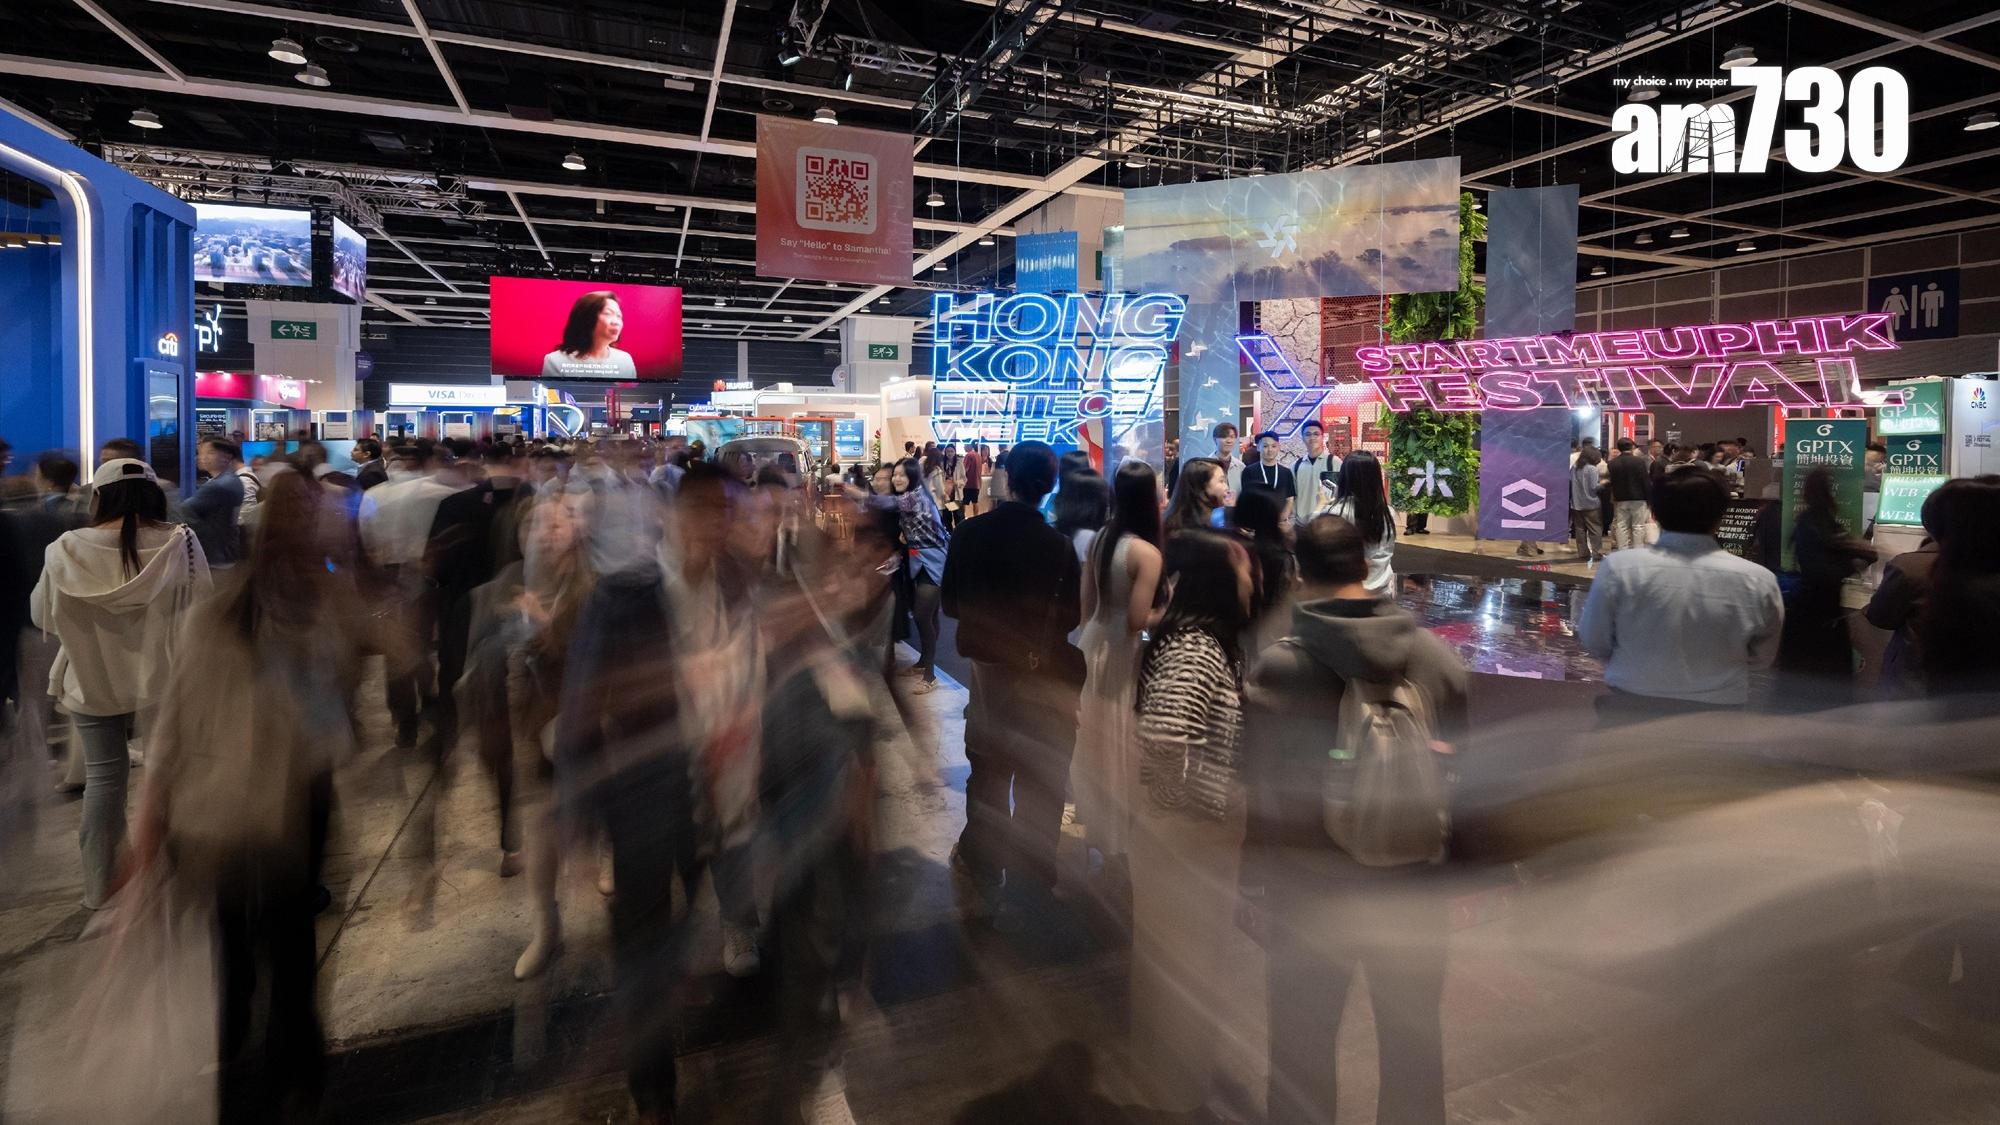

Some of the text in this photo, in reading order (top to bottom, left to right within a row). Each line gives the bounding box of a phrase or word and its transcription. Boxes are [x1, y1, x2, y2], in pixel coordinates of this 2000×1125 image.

[780, 237, 797, 248] Say
[833, 243, 842, 251] to
[933, 292, 1189, 344] HONG
[158, 334, 178, 357] citi
[1355, 312, 1901, 373] STARTMEUPHK
[932, 343, 1168, 387] KONG
[1370, 356, 1906, 412] FESTIVAL
[428, 390, 455, 399] VISA
[931, 389, 1160, 420] FINTECH
[1971, 401, 1987, 409] CNBC
[930, 418, 1087, 446] WEEK
[1796, 440, 1853, 454] GPTX
[1889, 453, 1938, 466] GPTX
[1884, 487, 1918, 498] WEB
[1879, 510, 1915, 521] WEB
